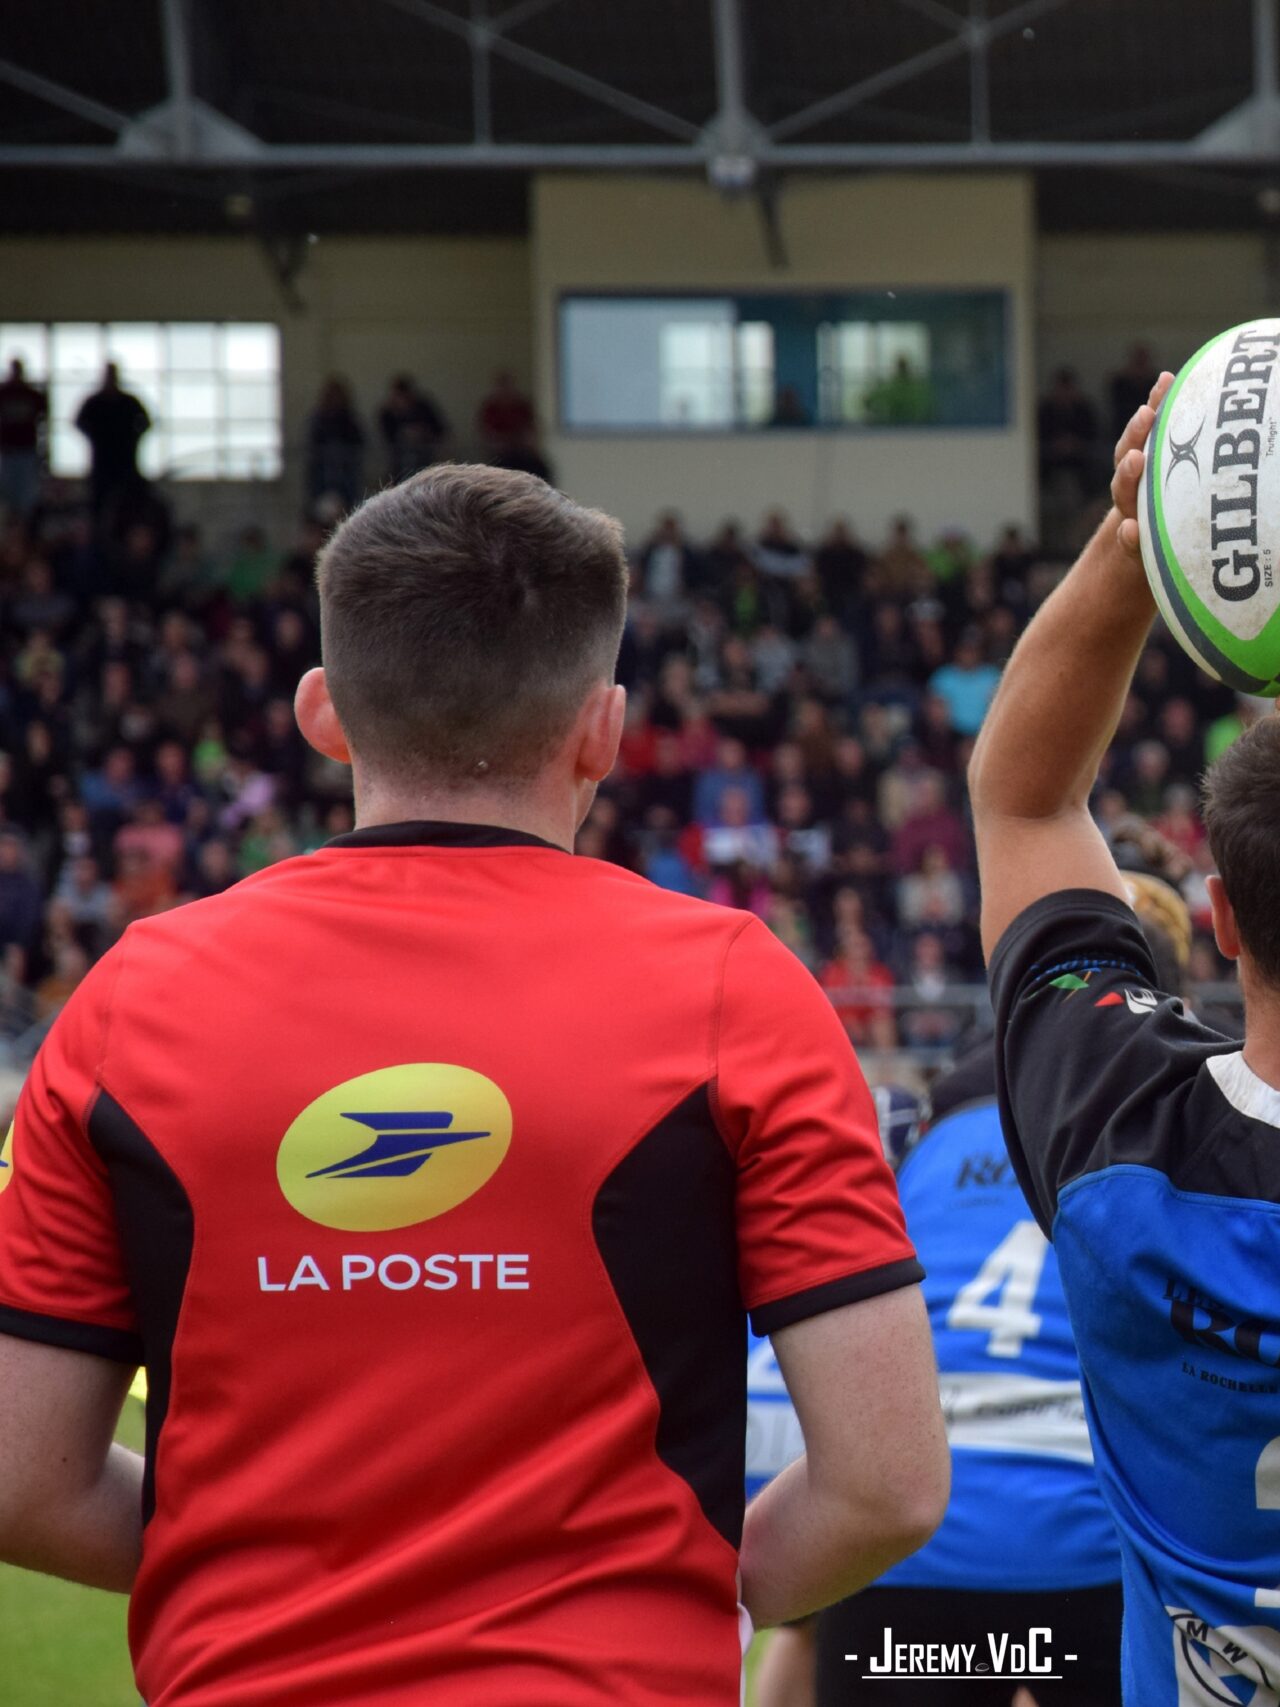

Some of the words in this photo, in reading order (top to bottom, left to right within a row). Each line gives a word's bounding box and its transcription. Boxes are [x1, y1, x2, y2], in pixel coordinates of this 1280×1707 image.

[1264, 564, 1274, 588] SIZE
[257, 1255, 330, 1291] LA
[341, 1253, 530, 1291] POSTE
[946, 1219, 1050, 1359] 4
[1200, 1369, 1279, 1394] ROCHELLE
